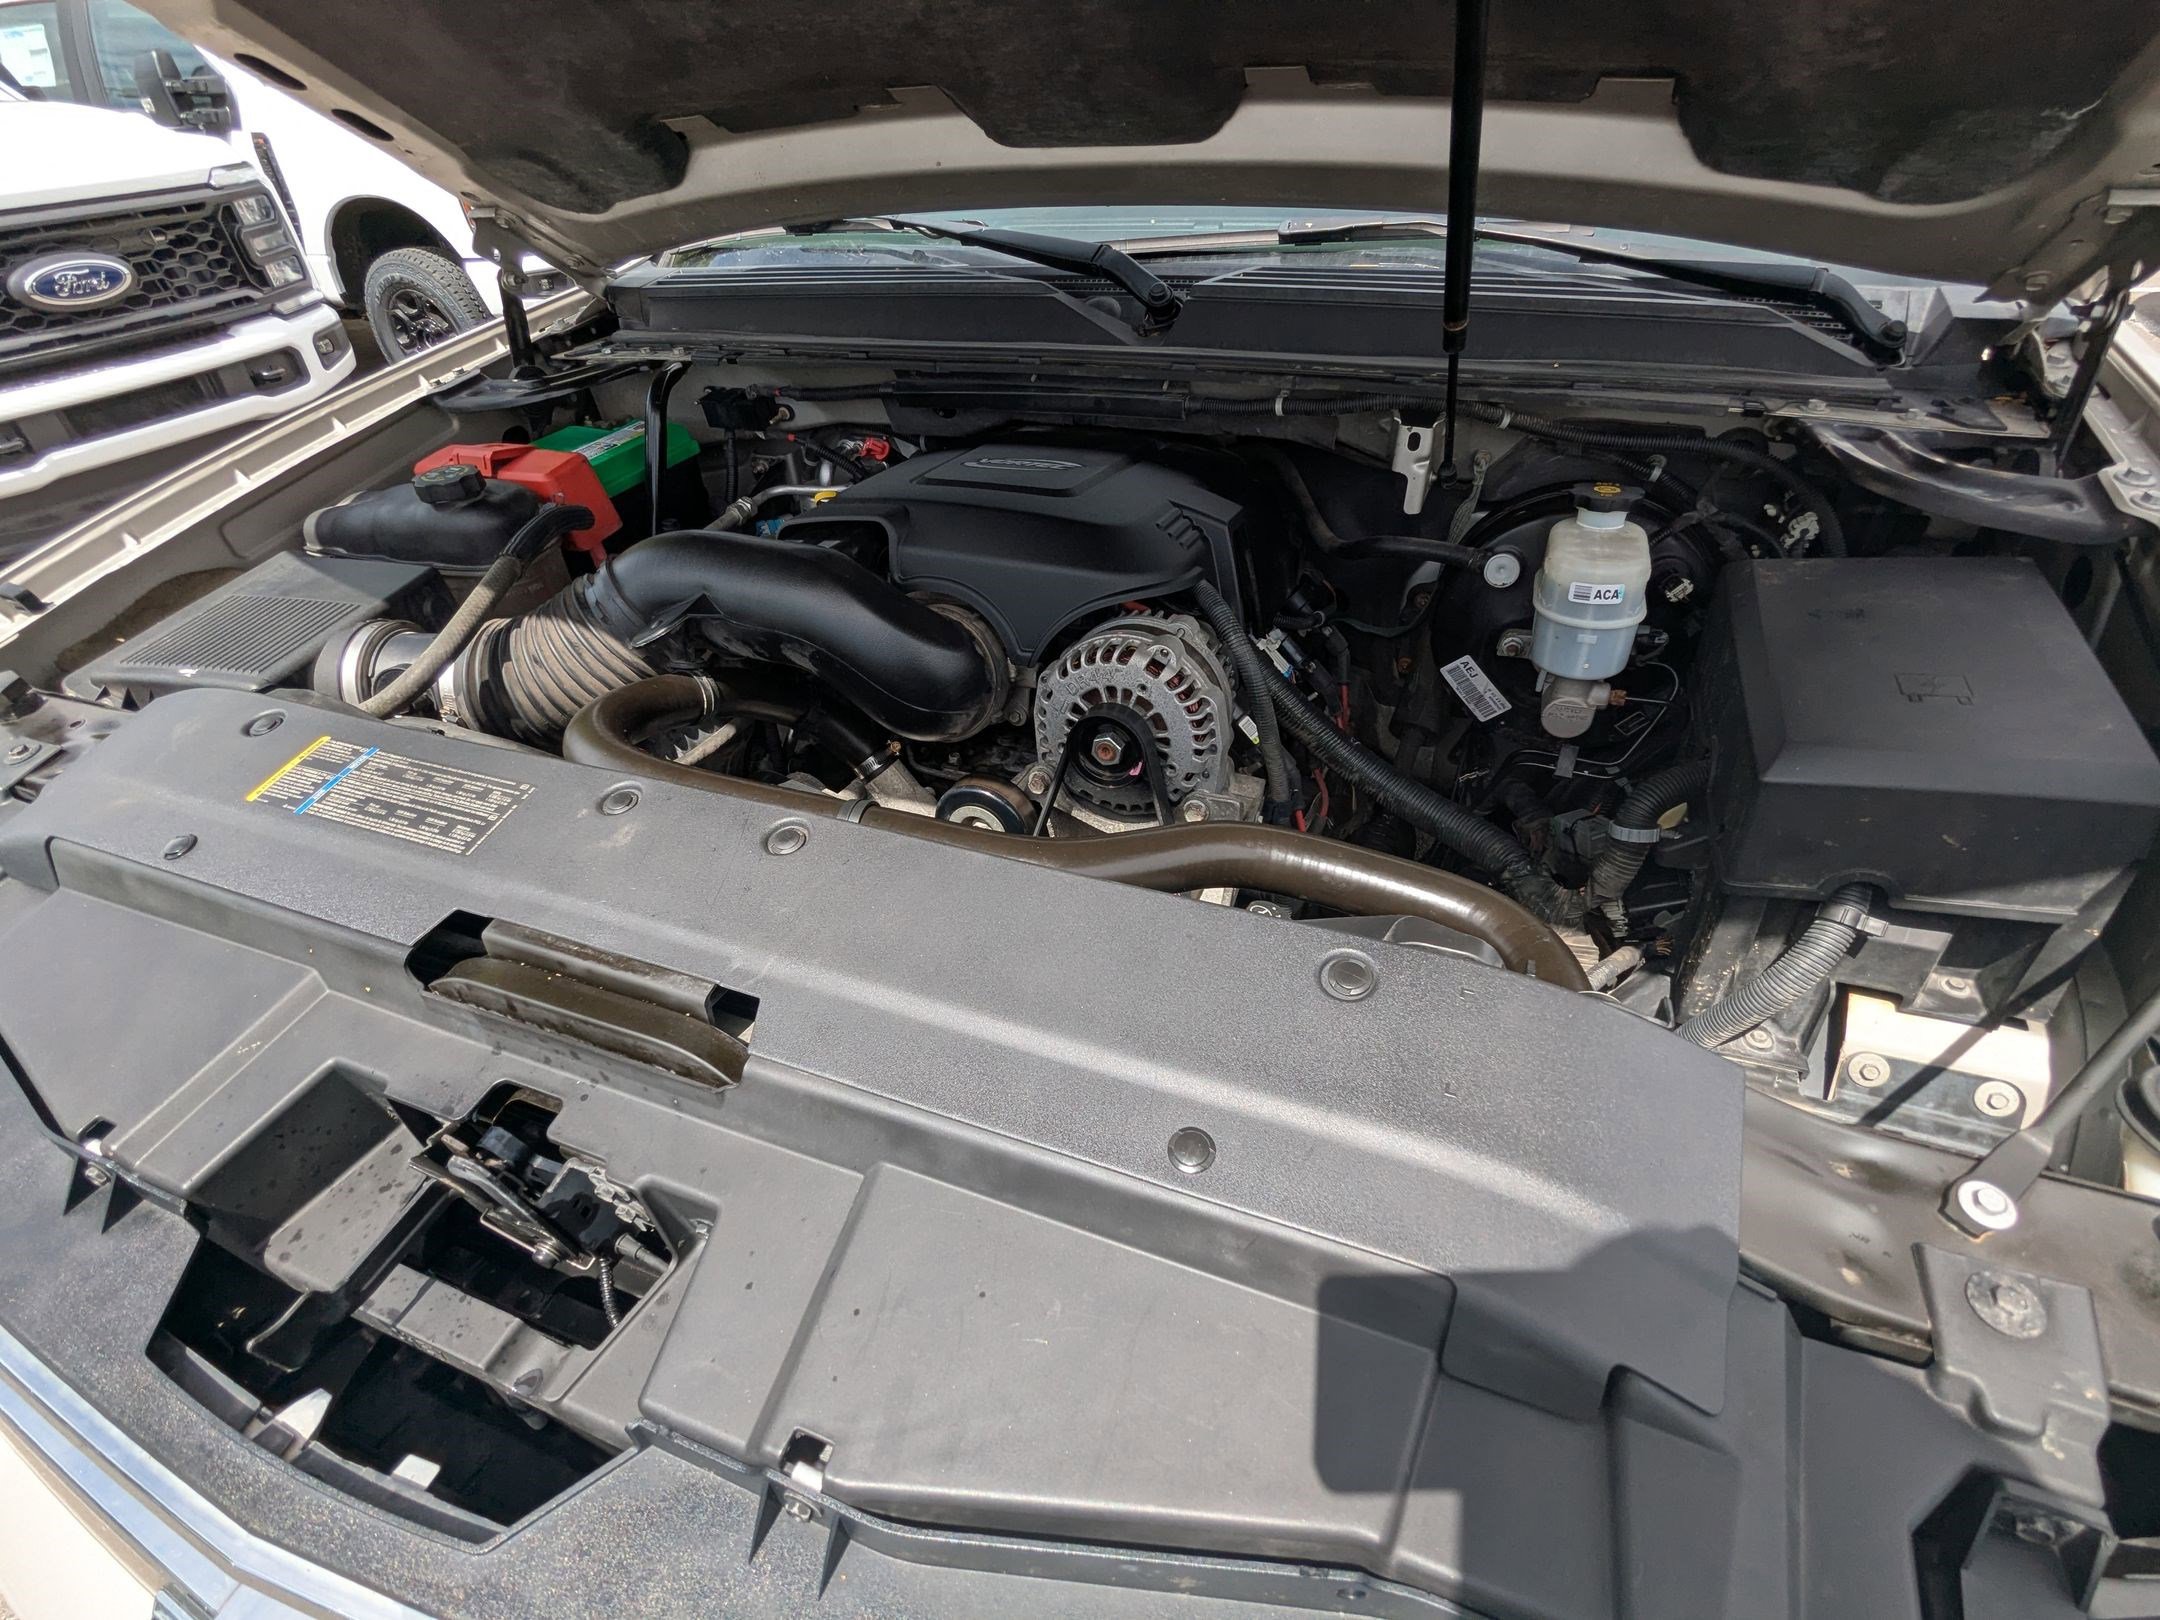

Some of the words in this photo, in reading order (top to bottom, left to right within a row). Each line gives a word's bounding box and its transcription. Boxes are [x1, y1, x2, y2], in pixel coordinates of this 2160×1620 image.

[53, 268, 110, 297] Ford
[1593, 589, 1619, 600] ACA
[1460, 661, 1478, 679] AEJ
